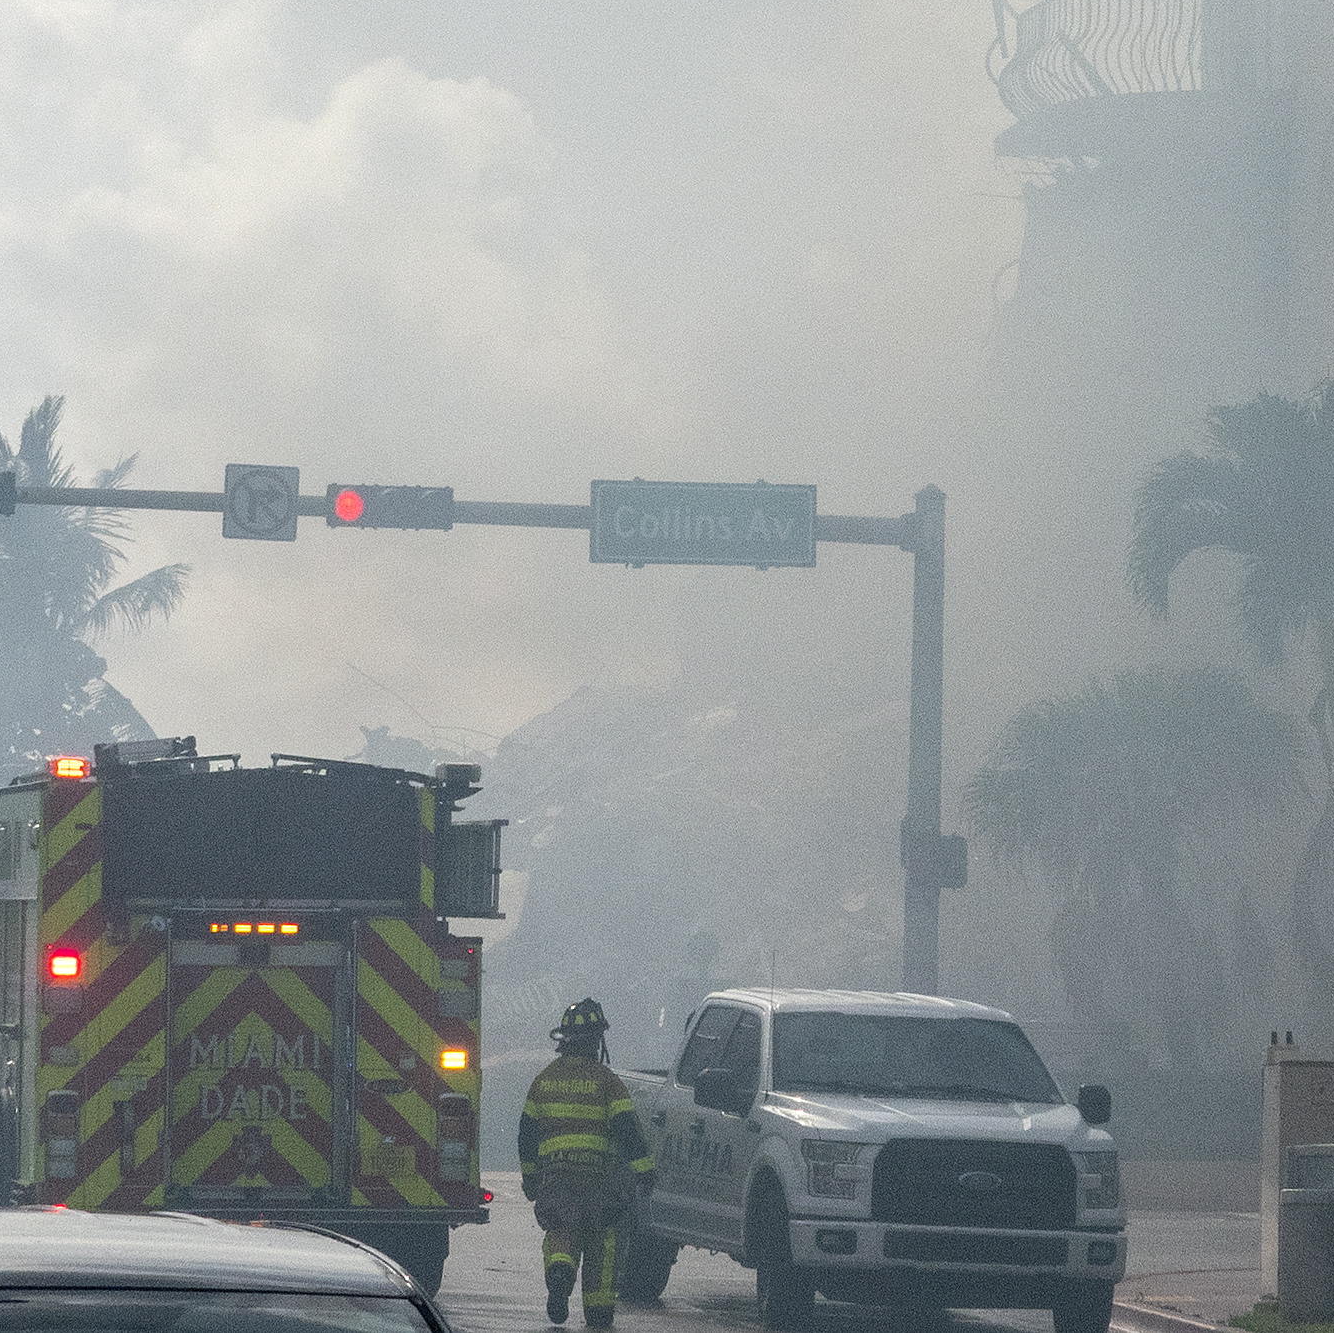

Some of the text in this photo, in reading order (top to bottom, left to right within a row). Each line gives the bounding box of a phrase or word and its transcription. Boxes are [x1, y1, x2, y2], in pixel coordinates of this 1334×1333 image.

[613, 503, 795, 542] Collins Av
[189, 1033, 321, 1070] MIAMI
[201, 1083, 308, 1120] DADE
[660, 1133, 734, 1175] ALPHA
